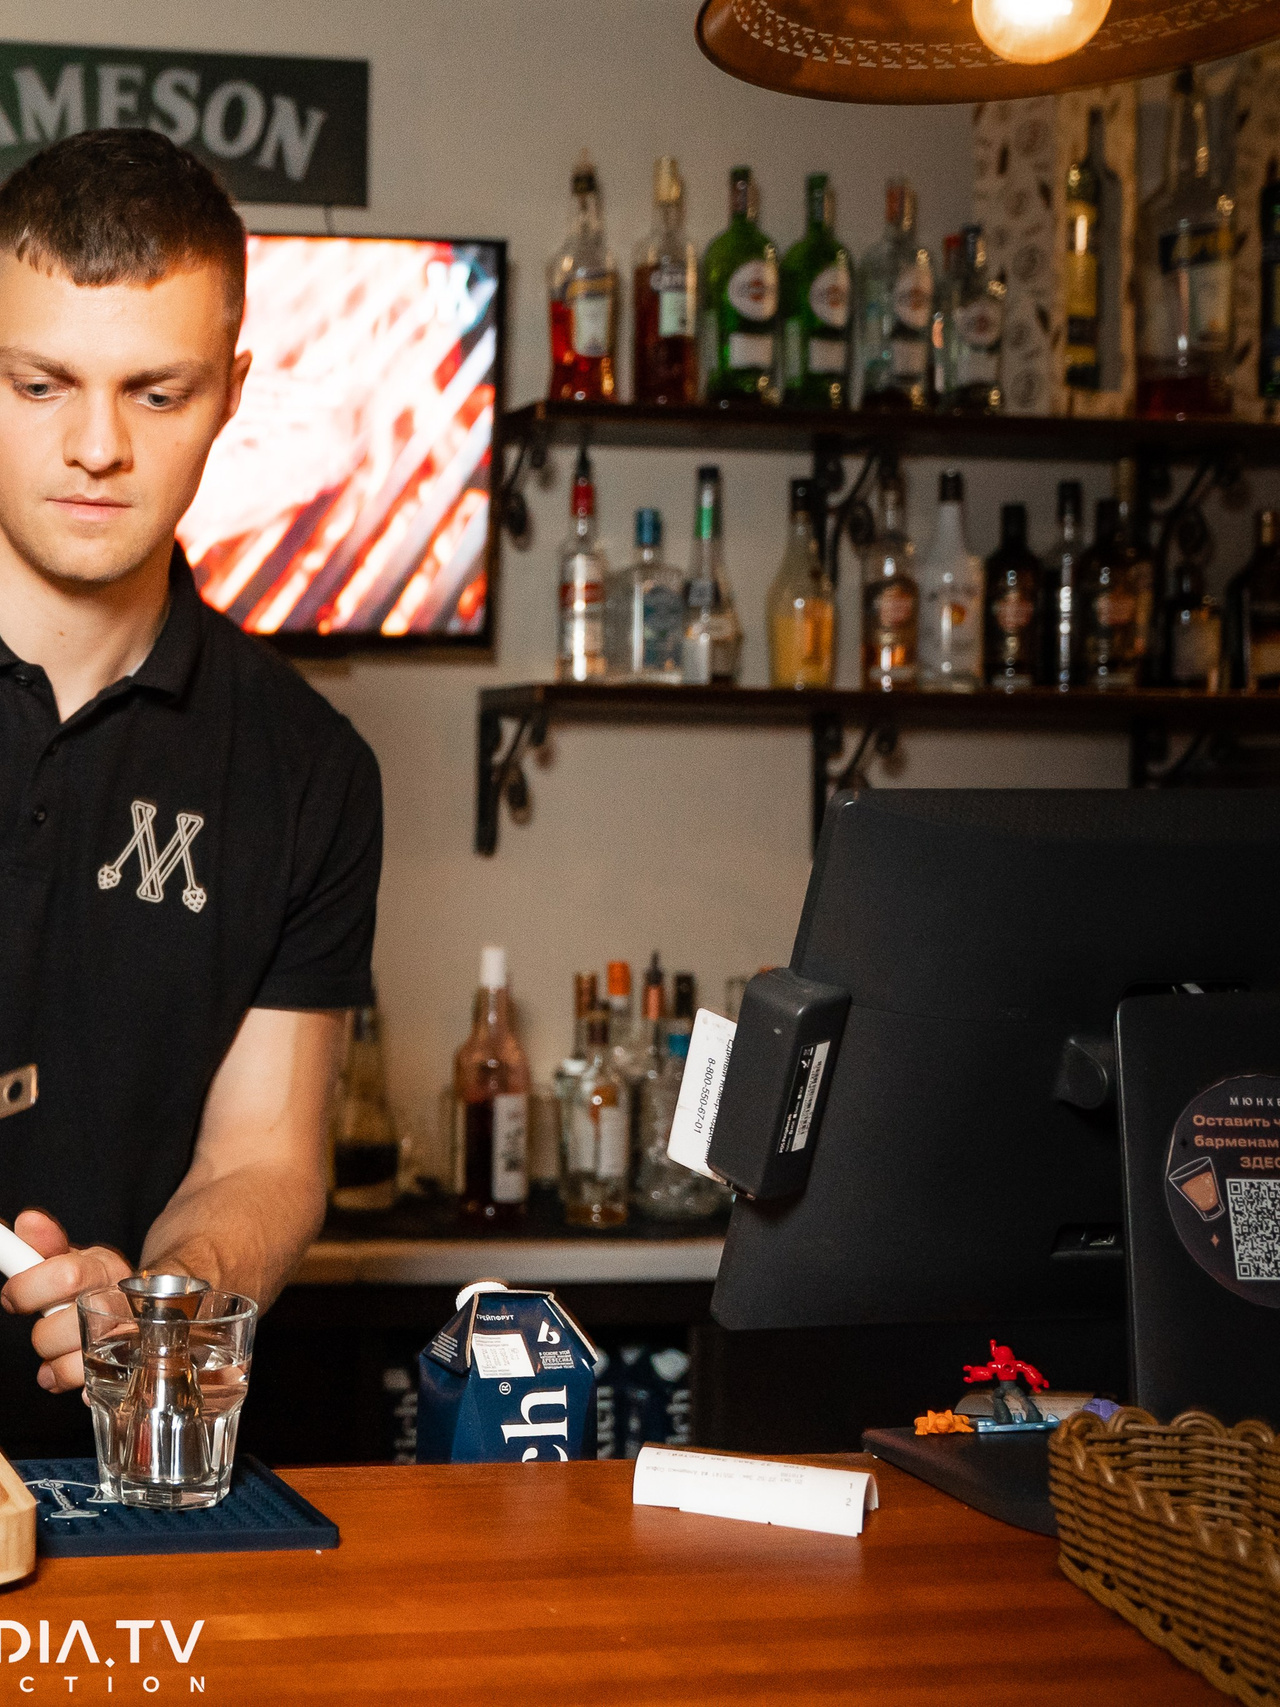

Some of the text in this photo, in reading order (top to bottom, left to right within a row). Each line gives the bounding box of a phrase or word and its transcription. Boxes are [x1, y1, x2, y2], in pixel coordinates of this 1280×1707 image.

[694, 1057, 716, 1134] 8-800-550-67-01
[1193, 1114, 1271, 1127] Оставить
[1194, 1135, 1279, 1149] барменам
